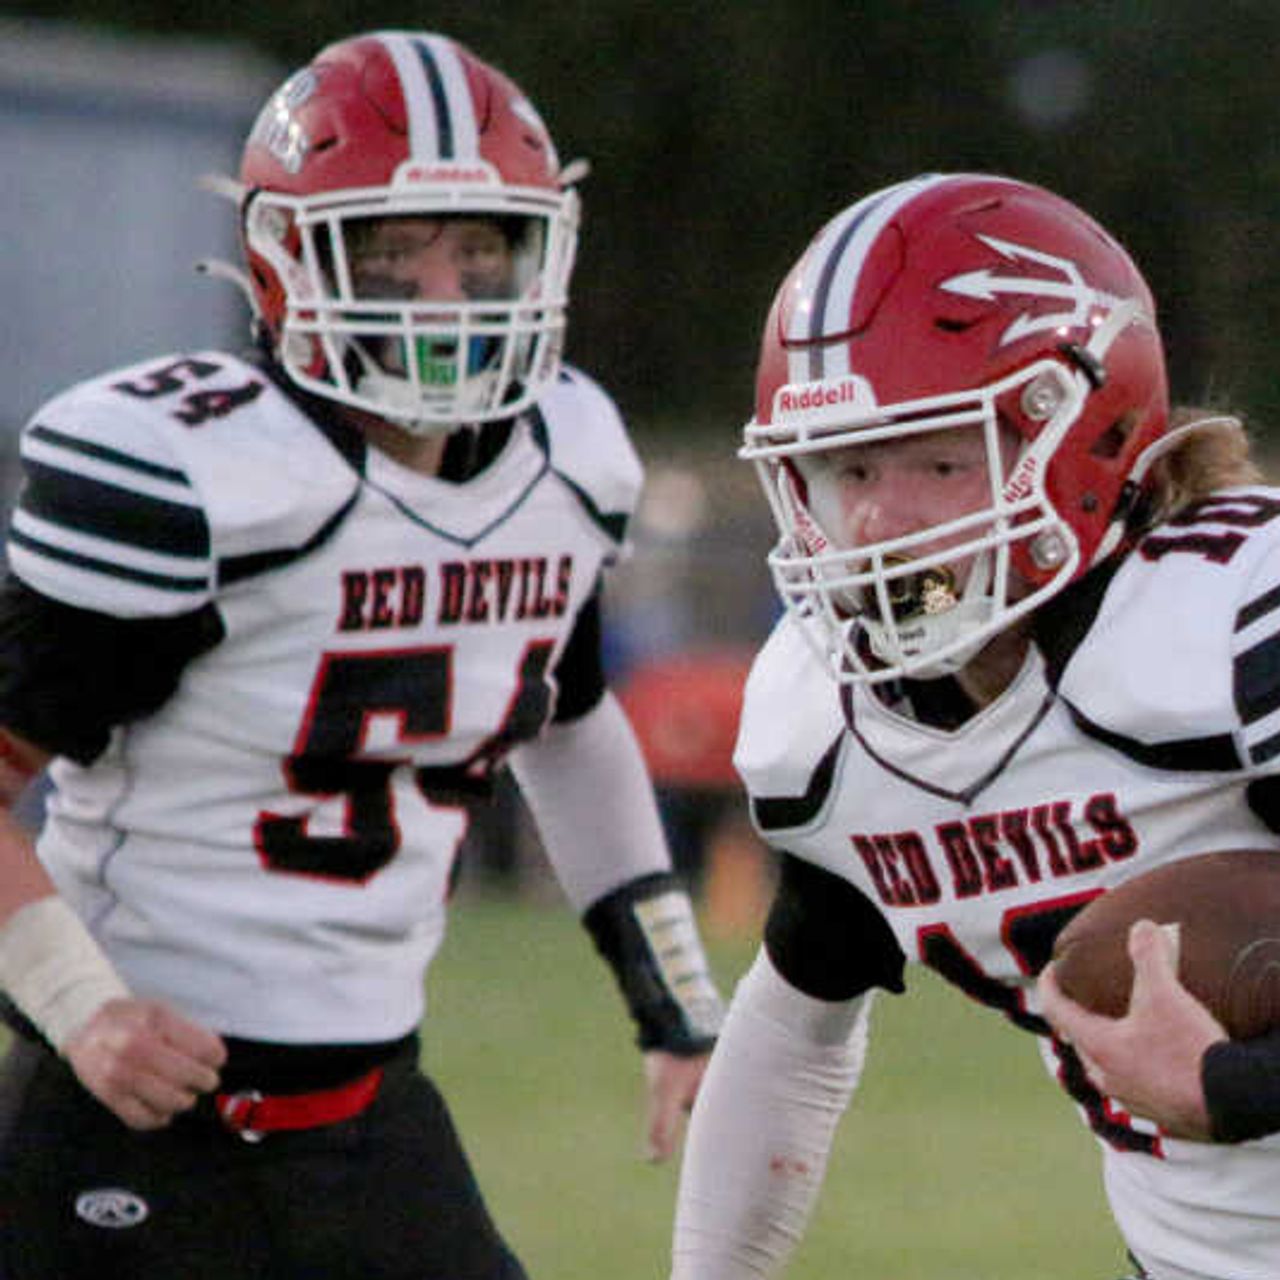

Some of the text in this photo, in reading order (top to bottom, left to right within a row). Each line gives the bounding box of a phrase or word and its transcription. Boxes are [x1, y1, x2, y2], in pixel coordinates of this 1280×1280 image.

[779, 380, 857, 412] Riddell
[334, 556, 571, 634] RED DEVILS
[935, 793, 1139, 902] DEVILS
